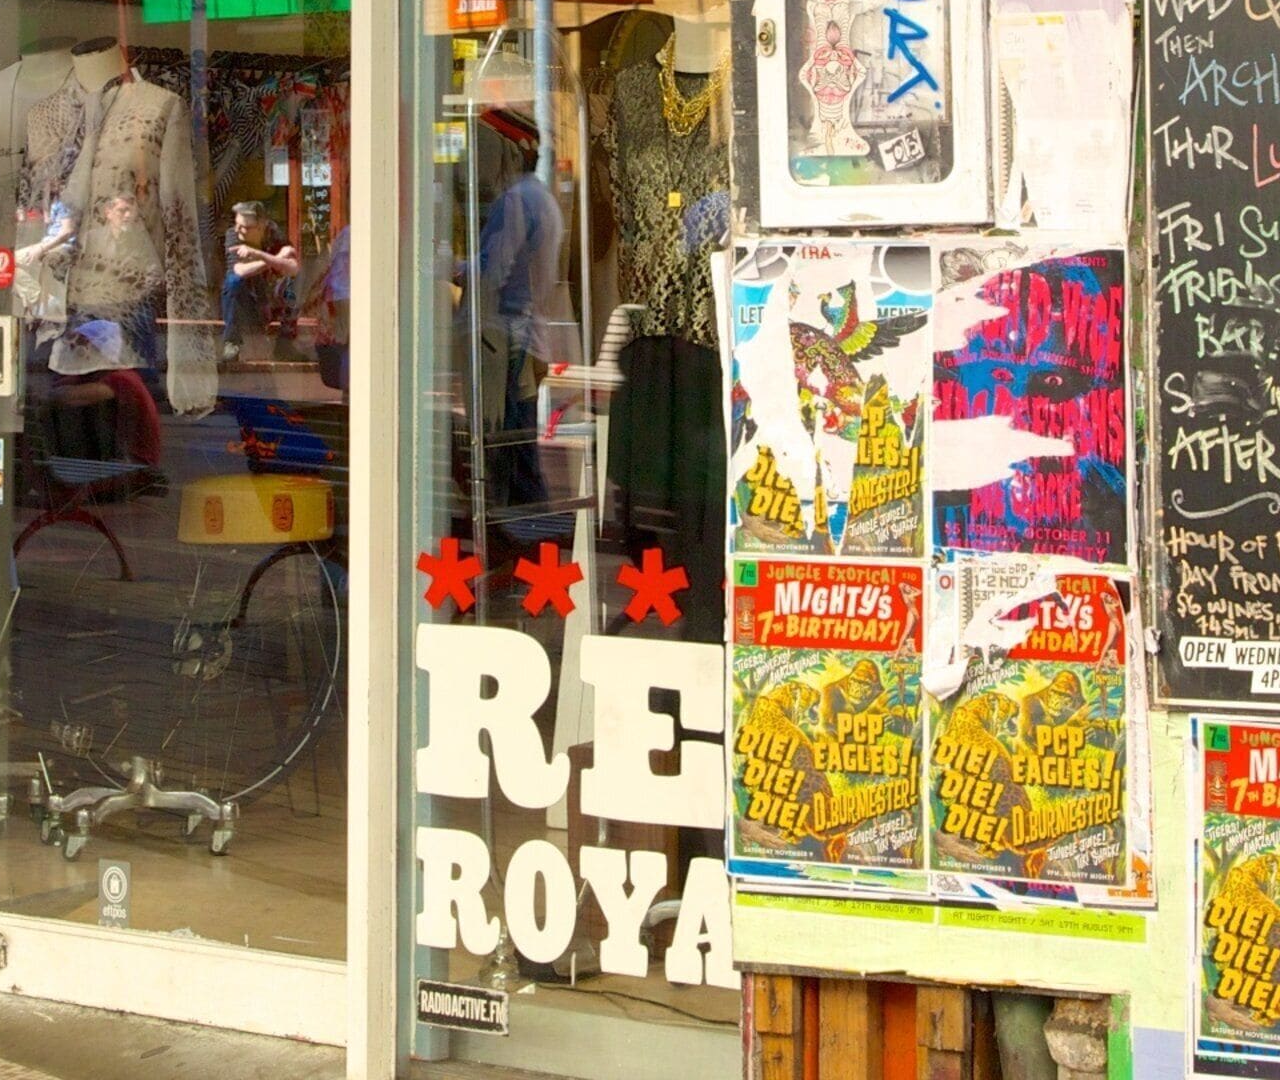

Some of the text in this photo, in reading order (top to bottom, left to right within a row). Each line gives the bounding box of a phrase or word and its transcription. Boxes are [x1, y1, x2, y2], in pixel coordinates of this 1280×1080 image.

[1154, 25, 1214, 63] THEN
[1153, 116, 1249, 170] THUR
[1158, 201, 1225, 263] FRI
[1027, 527, 1087, 542] OCTOBER
[1165, 525, 1267, 565] HOUR OF
[1179, 559, 1219, 594] DAY
[786, 614, 900, 646] BIRTHDAY!
[1184, 640, 1227, 663] OPEN
[737, 724, 800, 767] DIE!
[838, 713, 884, 745] PCP
[1036, 724, 1086, 757] PCP
[814, 737, 912, 776] EAGLES!
[935, 735, 998, 780] DIE!
[1012, 751, 1115, 789] EAGLES!
[743, 758, 805, 801] DIE!
[940, 770, 1004, 814] DIE!
[748, 791, 810, 836] DIE!
[944, 804, 1008, 850] DIE!
[1207, 897, 1272, 944] DIE!
[1214, 932, 1280, 980] DIE!
[421, 989, 504, 1026] RADIOACTIVE.FM
[1211, 1026, 1244, 1037] SATURDAY
